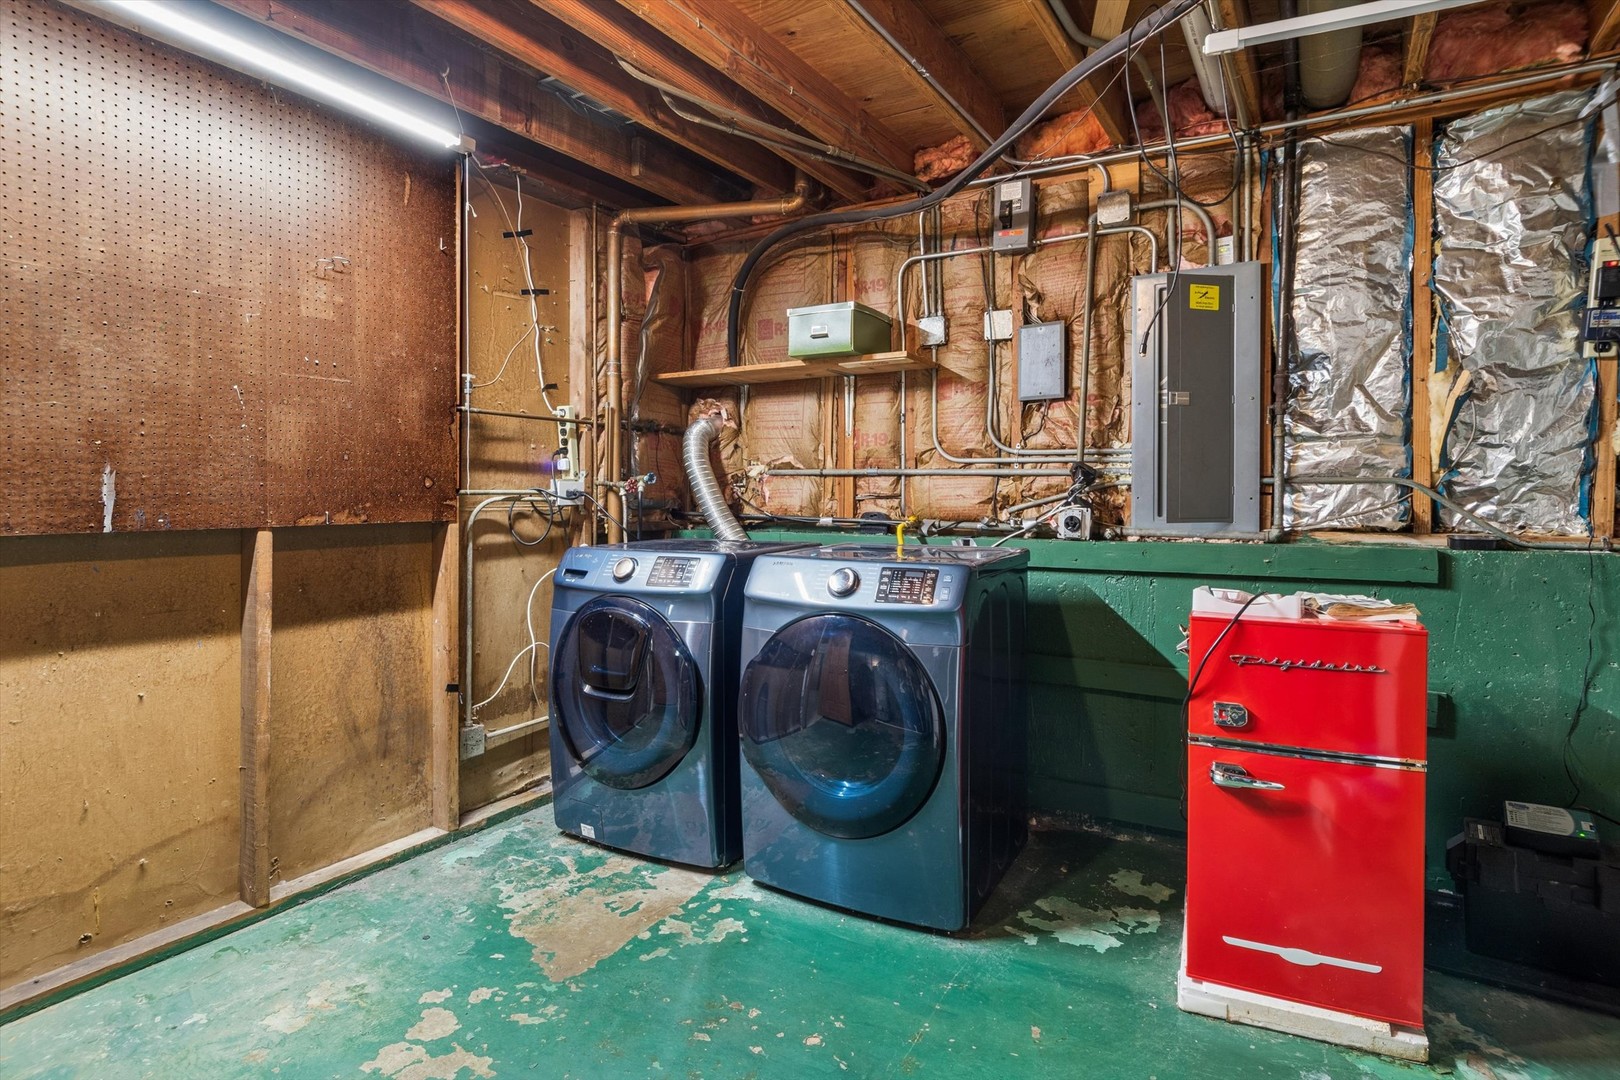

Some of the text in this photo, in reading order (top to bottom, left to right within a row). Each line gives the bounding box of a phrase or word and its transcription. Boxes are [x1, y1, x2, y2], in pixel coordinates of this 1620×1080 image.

[774, 322, 788, 335] R-
[861, 432, 888, 447] R-19
[1229, 653, 1386, 673] Frigidaire
